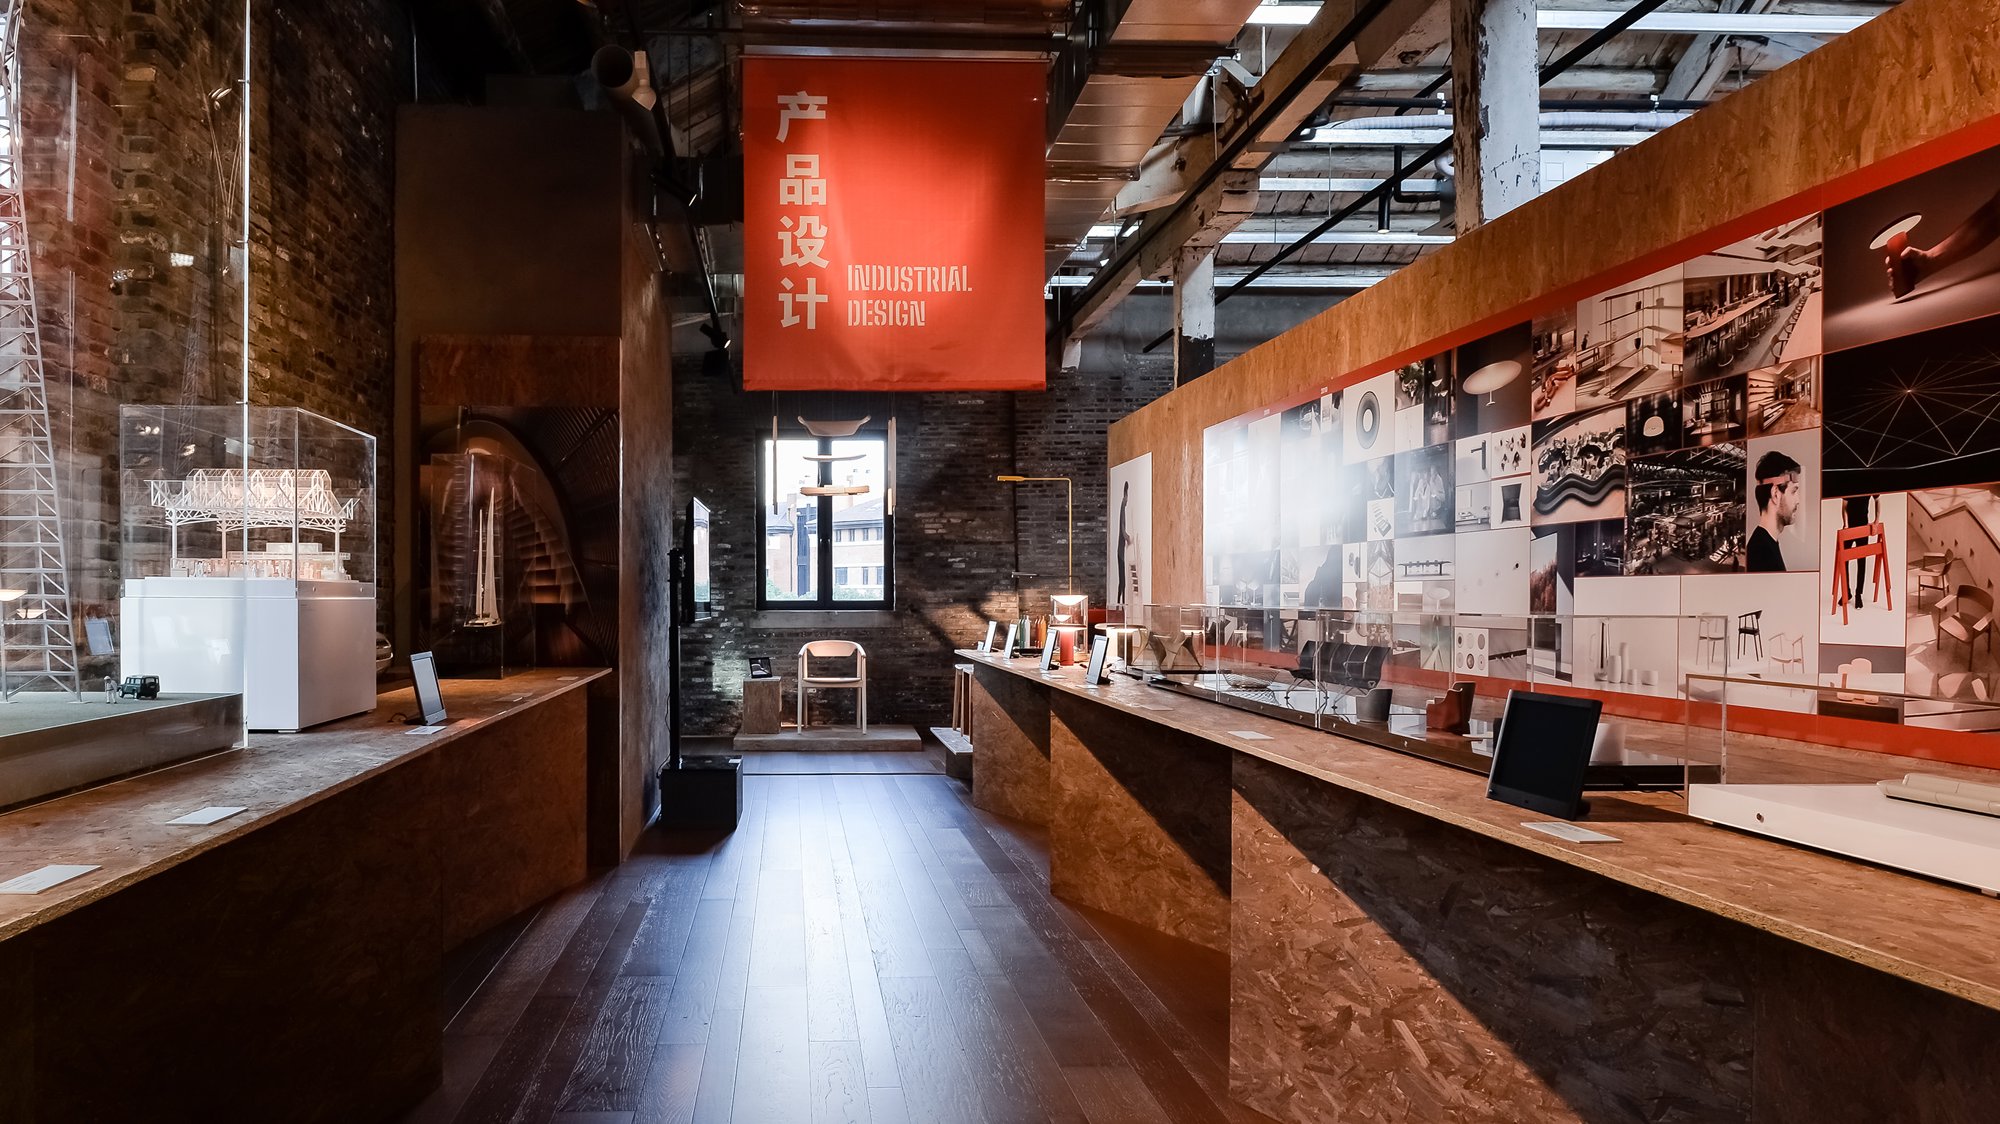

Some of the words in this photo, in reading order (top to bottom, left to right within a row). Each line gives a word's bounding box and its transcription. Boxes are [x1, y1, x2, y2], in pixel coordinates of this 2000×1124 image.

[776, 91, 829, 329] 产品设计
[848, 264, 972, 292] INDUSTRIAL
[848, 299, 926, 327] DESIGN
